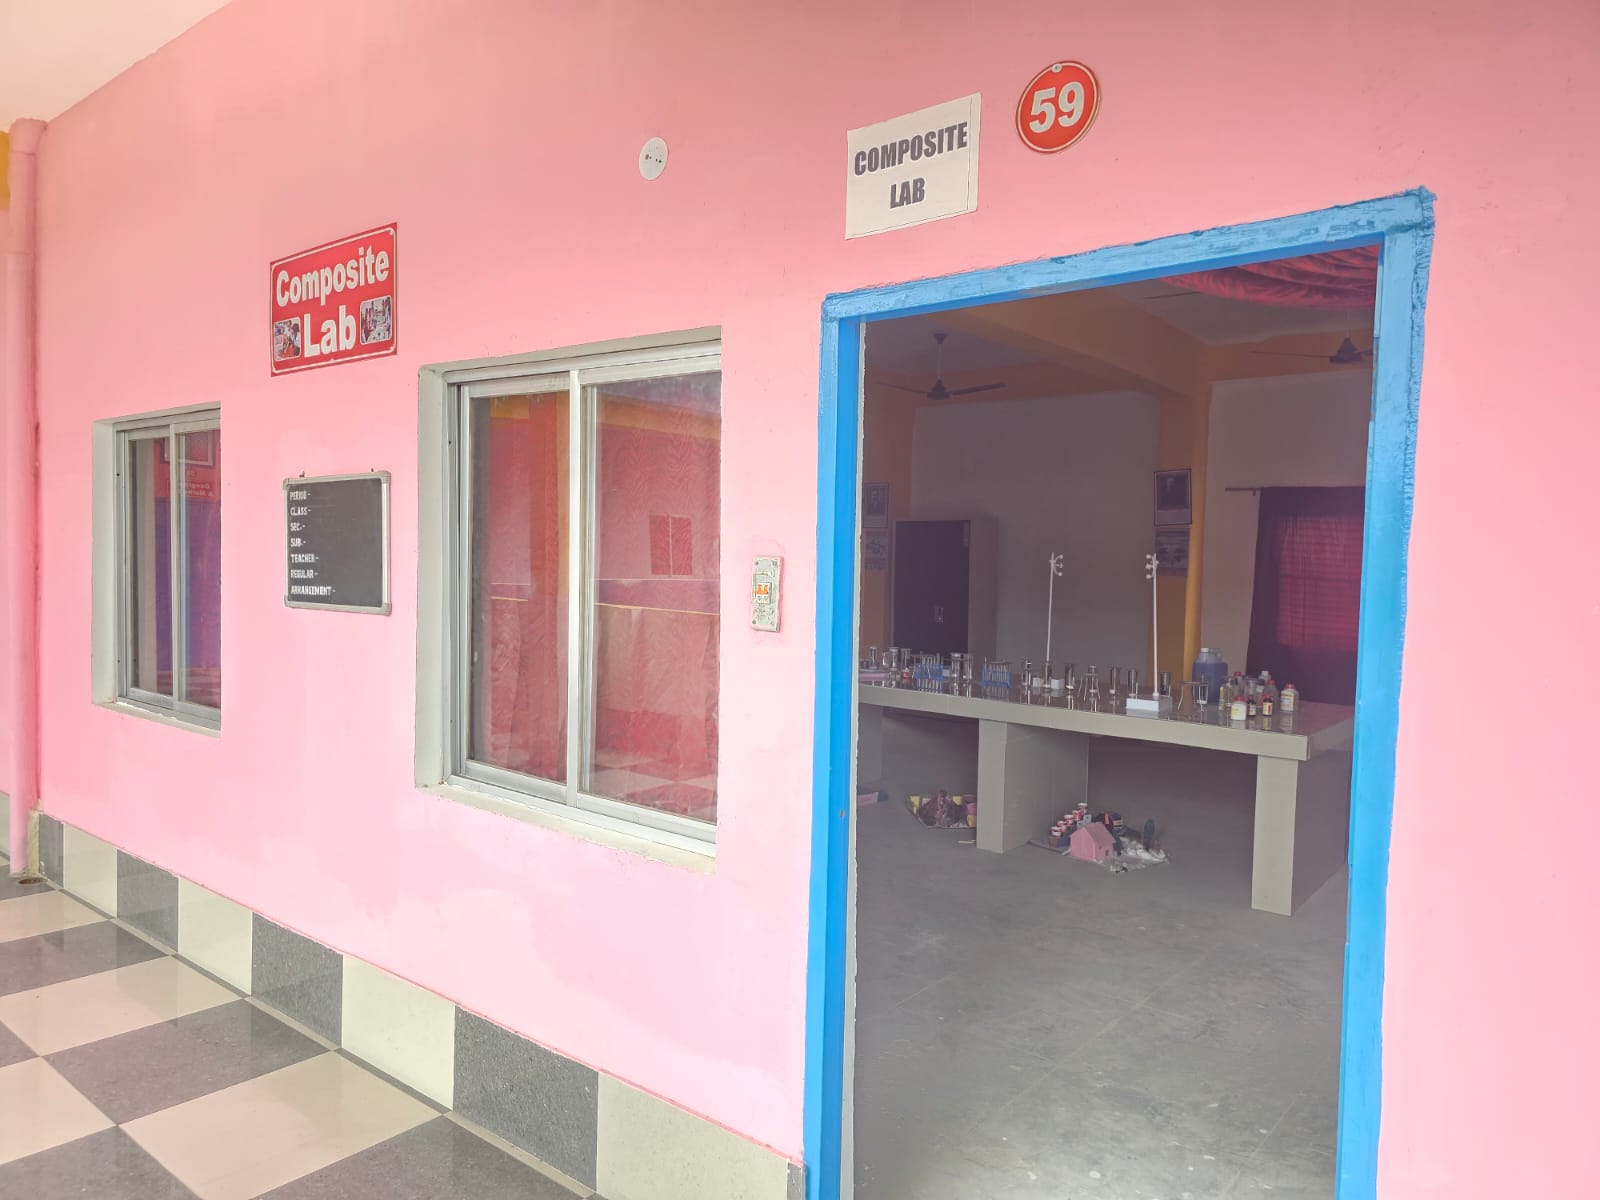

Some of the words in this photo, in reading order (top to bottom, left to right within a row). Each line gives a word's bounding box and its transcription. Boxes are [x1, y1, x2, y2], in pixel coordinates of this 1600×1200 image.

[1029, 81, 1085, 133] 59
[854, 121, 968, 176] COMPOSITE
[889, 177, 925, 209] LAB
[276, 244, 390, 307] Composite
[303, 305, 357, 358] Lab
